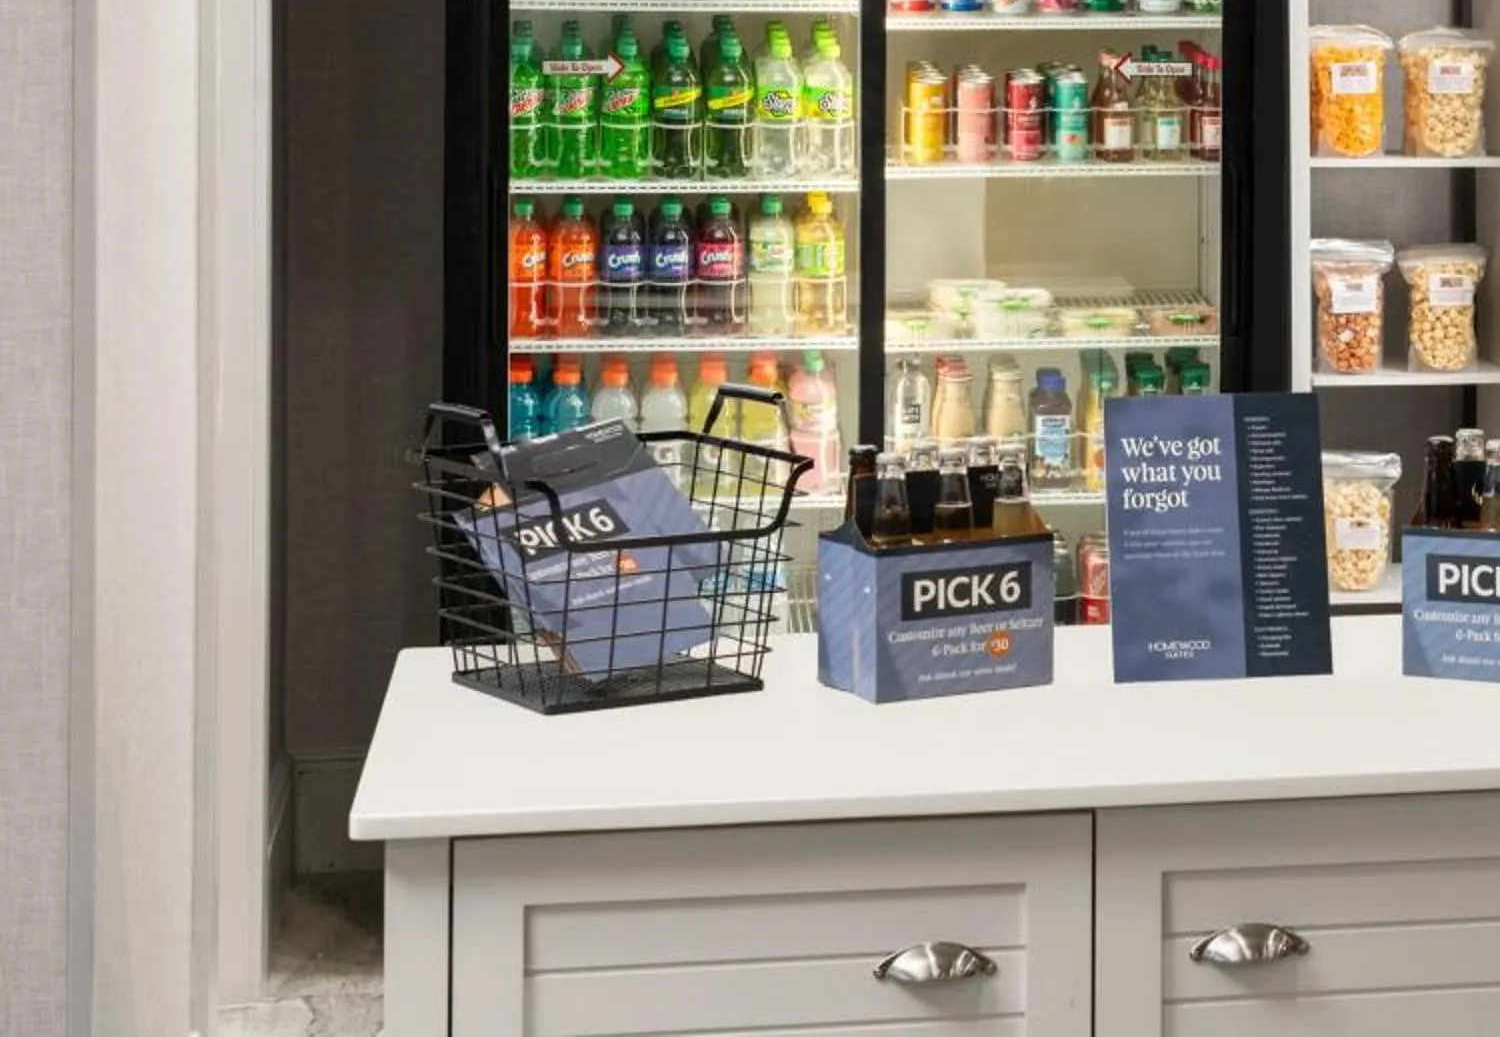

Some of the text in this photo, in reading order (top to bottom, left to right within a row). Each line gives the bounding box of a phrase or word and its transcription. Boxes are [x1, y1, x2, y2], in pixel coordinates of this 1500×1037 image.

[608, 251, 641, 269] Crush
[1120, 436, 1222, 460] We've got
[1121, 462, 1222, 487] what you
[1122, 488, 1189, 512] forgot
[591, 506, 616, 535] 6
[912, 570, 1021, 612] PICK 6
